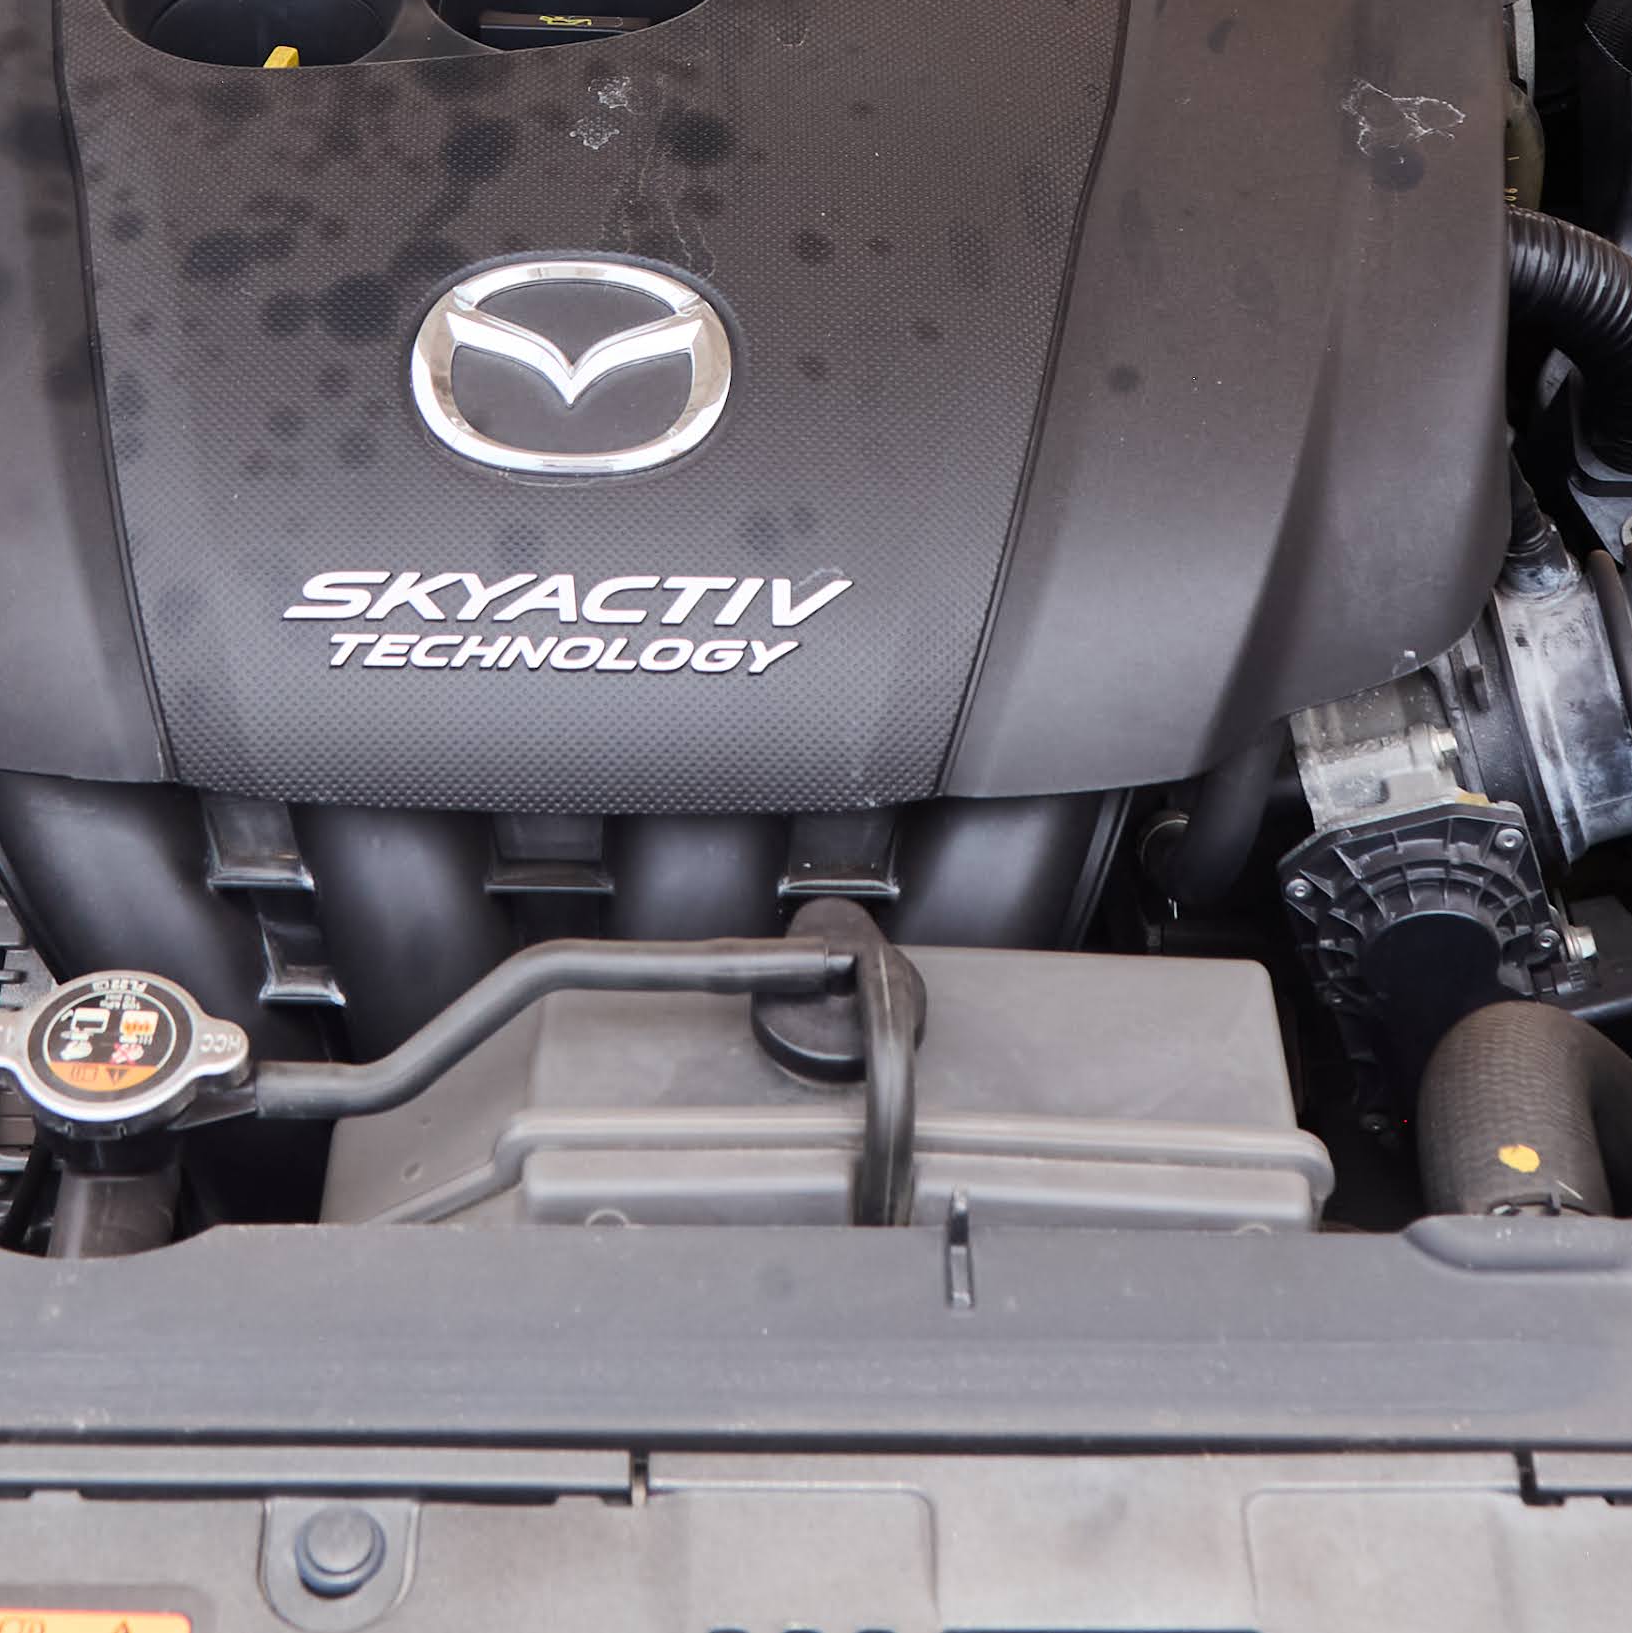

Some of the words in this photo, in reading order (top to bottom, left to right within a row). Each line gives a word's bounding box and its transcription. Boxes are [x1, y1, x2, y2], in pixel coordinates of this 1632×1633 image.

[281, 570, 854, 627] SKYACTIV
[328, 632, 801, 675] TECHNOLOGY
[199, 1032, 242, 1053] HCC
